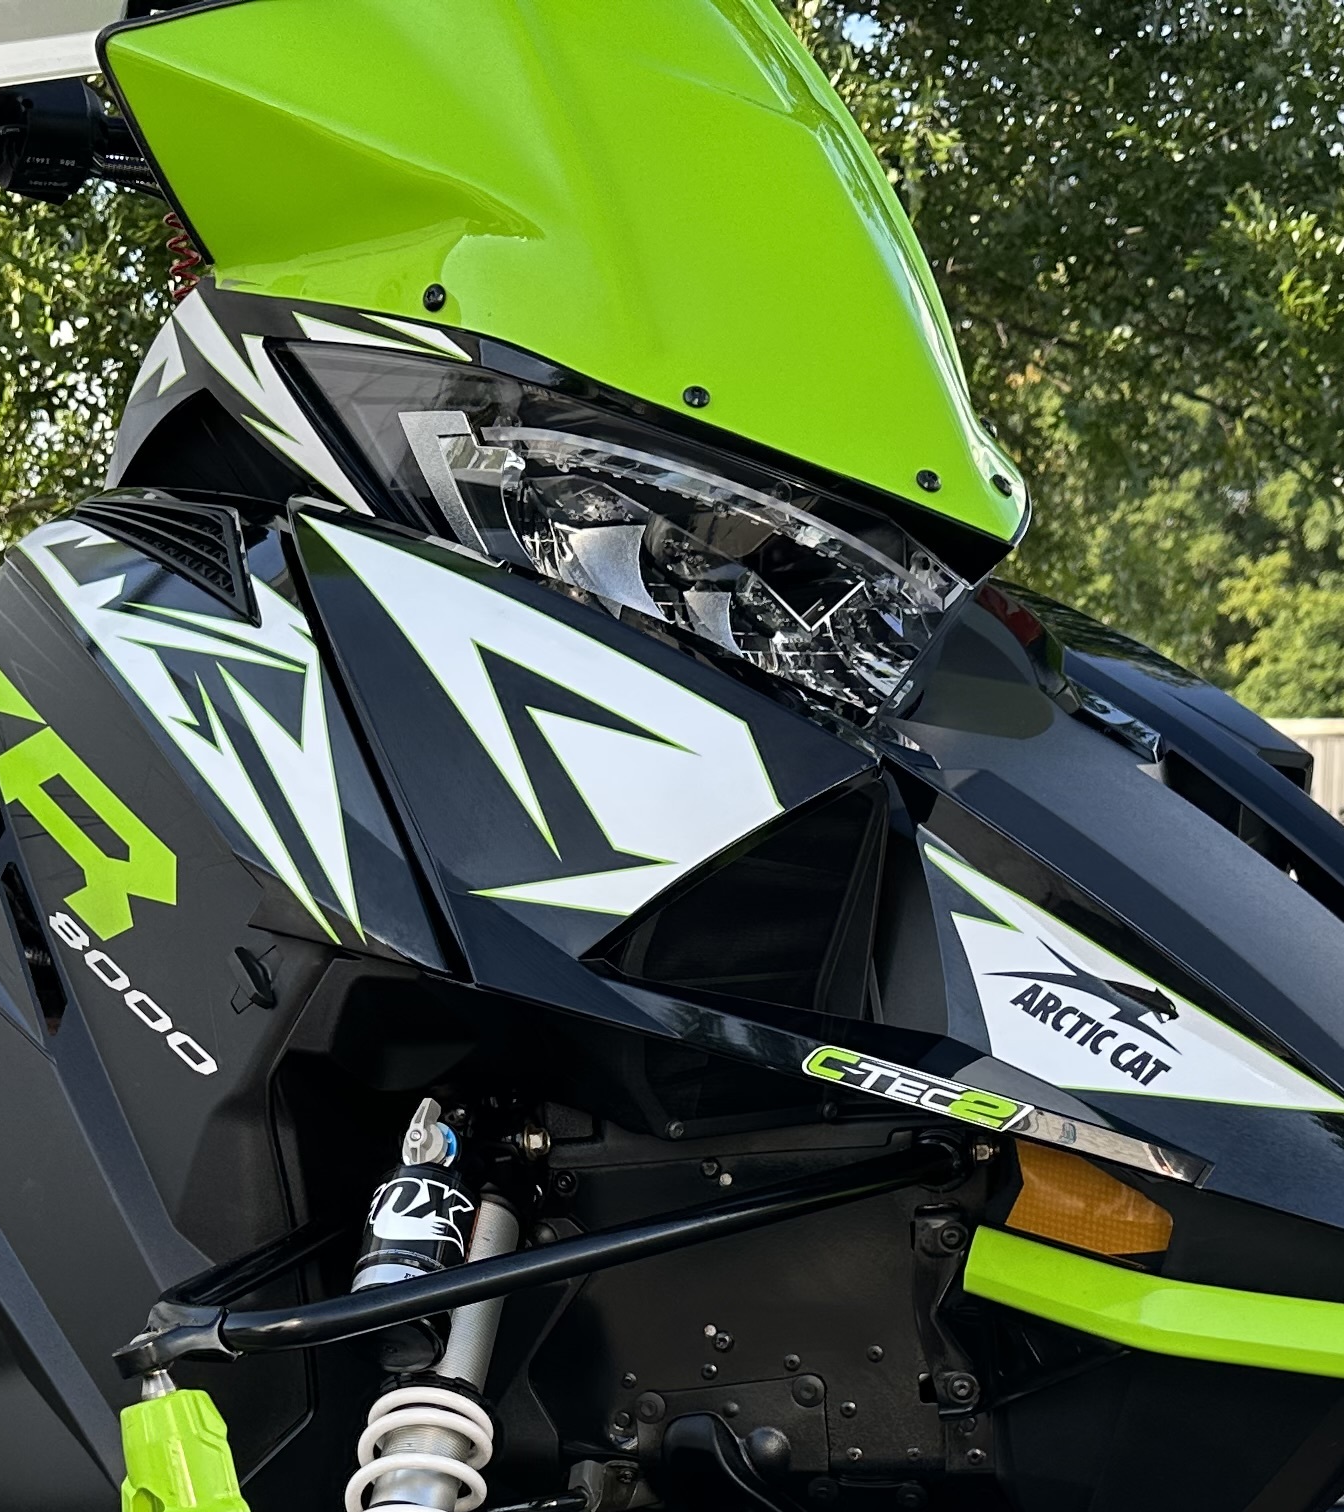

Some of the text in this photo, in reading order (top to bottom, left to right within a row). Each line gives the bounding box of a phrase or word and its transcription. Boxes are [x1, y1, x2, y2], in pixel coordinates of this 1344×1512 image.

[48, 911, 219, 1075] 8000
[1009, 983, 1173, 1086] ARCTIC CAT
